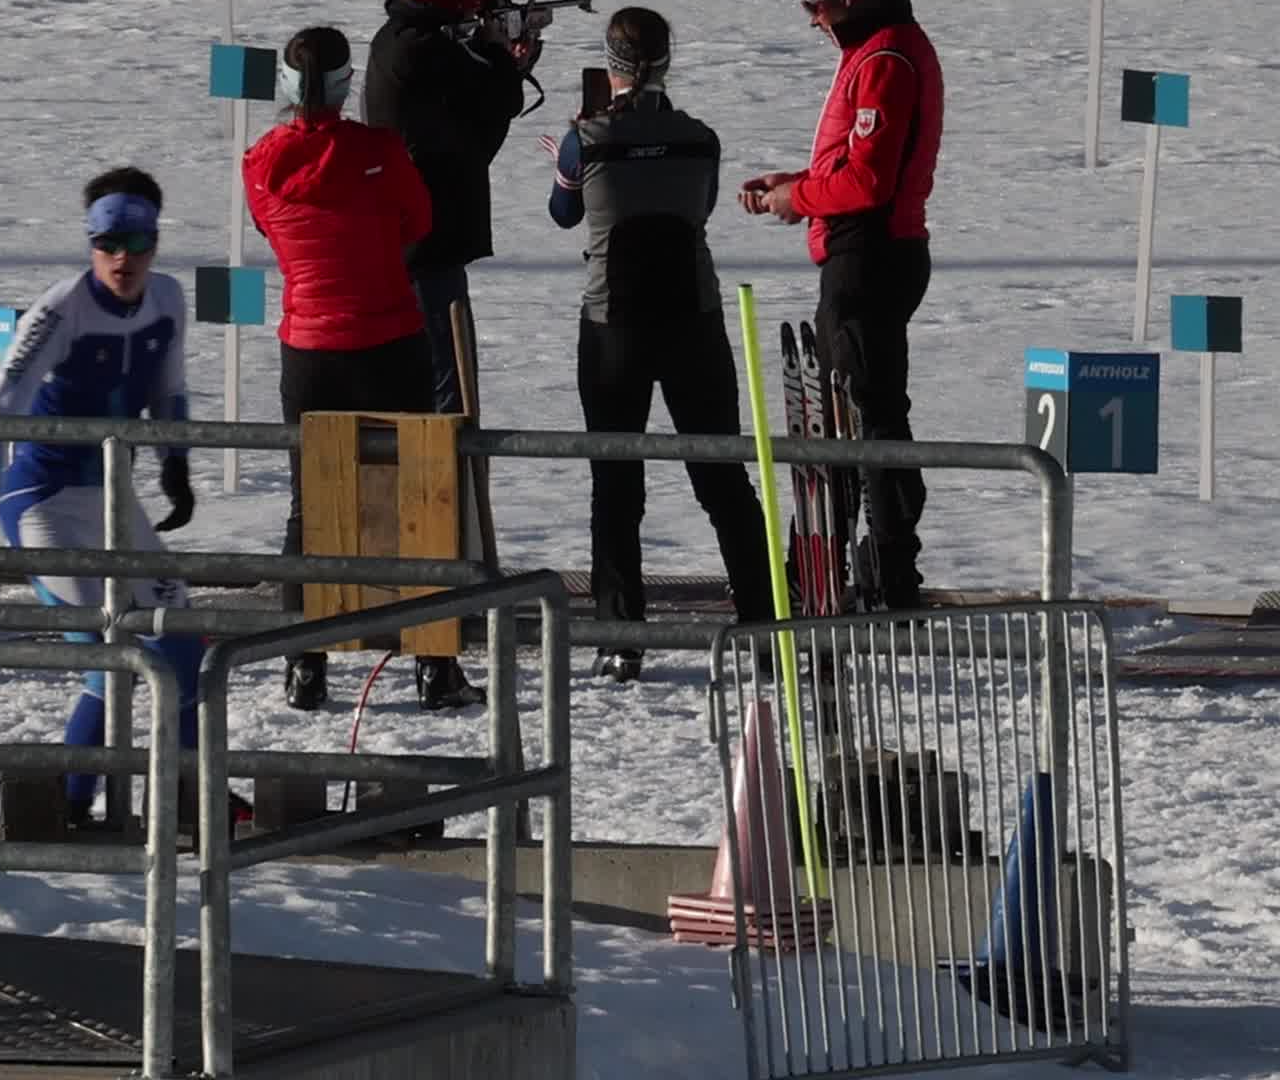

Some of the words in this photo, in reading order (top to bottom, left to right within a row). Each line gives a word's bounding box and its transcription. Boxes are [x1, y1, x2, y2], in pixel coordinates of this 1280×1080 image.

[1078, 363, 1152, 380] ANTHOLZ
[1037, 392, 1056, 451] 2
[1098, 394, 1126, 470] 1
